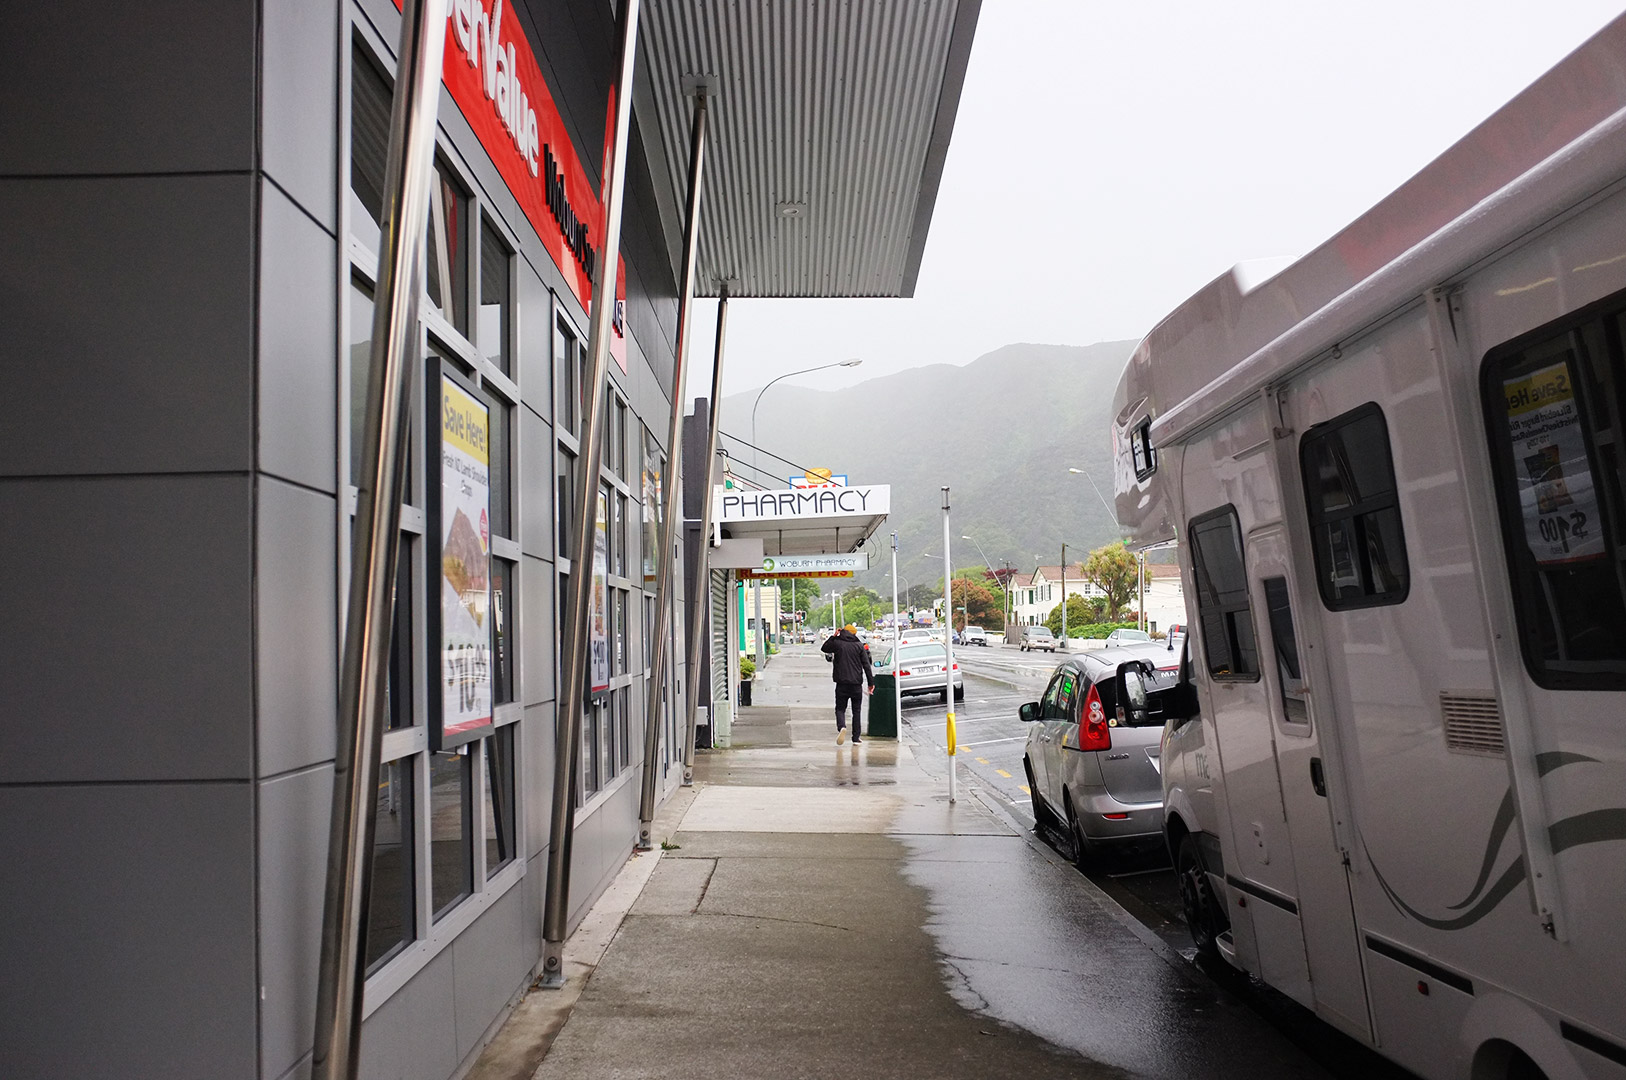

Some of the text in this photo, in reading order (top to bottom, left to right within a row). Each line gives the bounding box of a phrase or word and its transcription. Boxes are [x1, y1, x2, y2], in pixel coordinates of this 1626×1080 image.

[446, 0, 539, 178] erValue
[445, 395, 487, 453] Save Here!
[723, 489, 871, 518] PHARMACY
[779, 558, 856, 568] WOBURN PHARMACY
